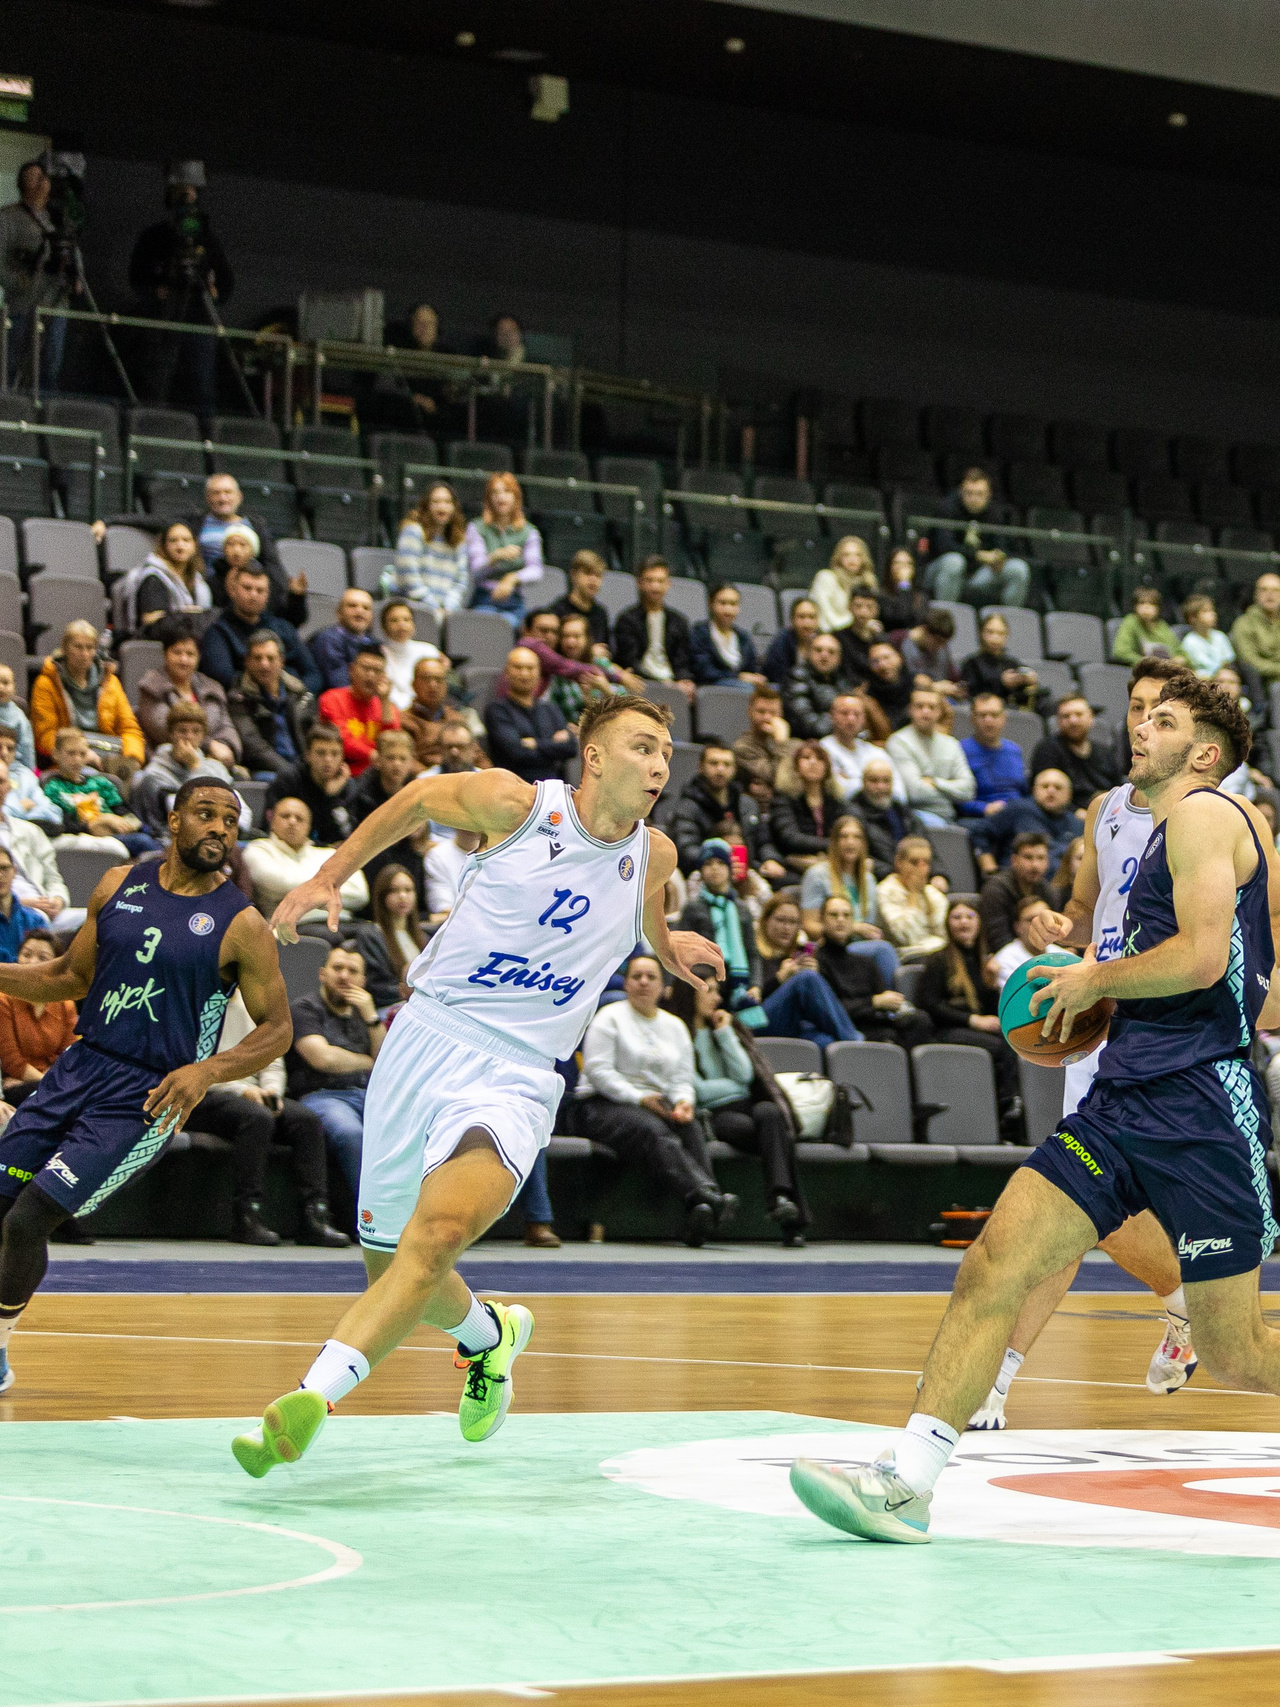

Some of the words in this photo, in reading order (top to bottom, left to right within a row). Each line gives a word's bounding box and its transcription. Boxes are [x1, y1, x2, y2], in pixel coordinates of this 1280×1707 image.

[537, 826, 560, 838] ENISEY
[115, 900, 144, 914] Kempa
[537, 887, 591, 935] 12
[135, 926, 163, 964] 3
[468, 951, 586, 1007] Enisey
[1058, 1132, 1104, 1176] евроопт
